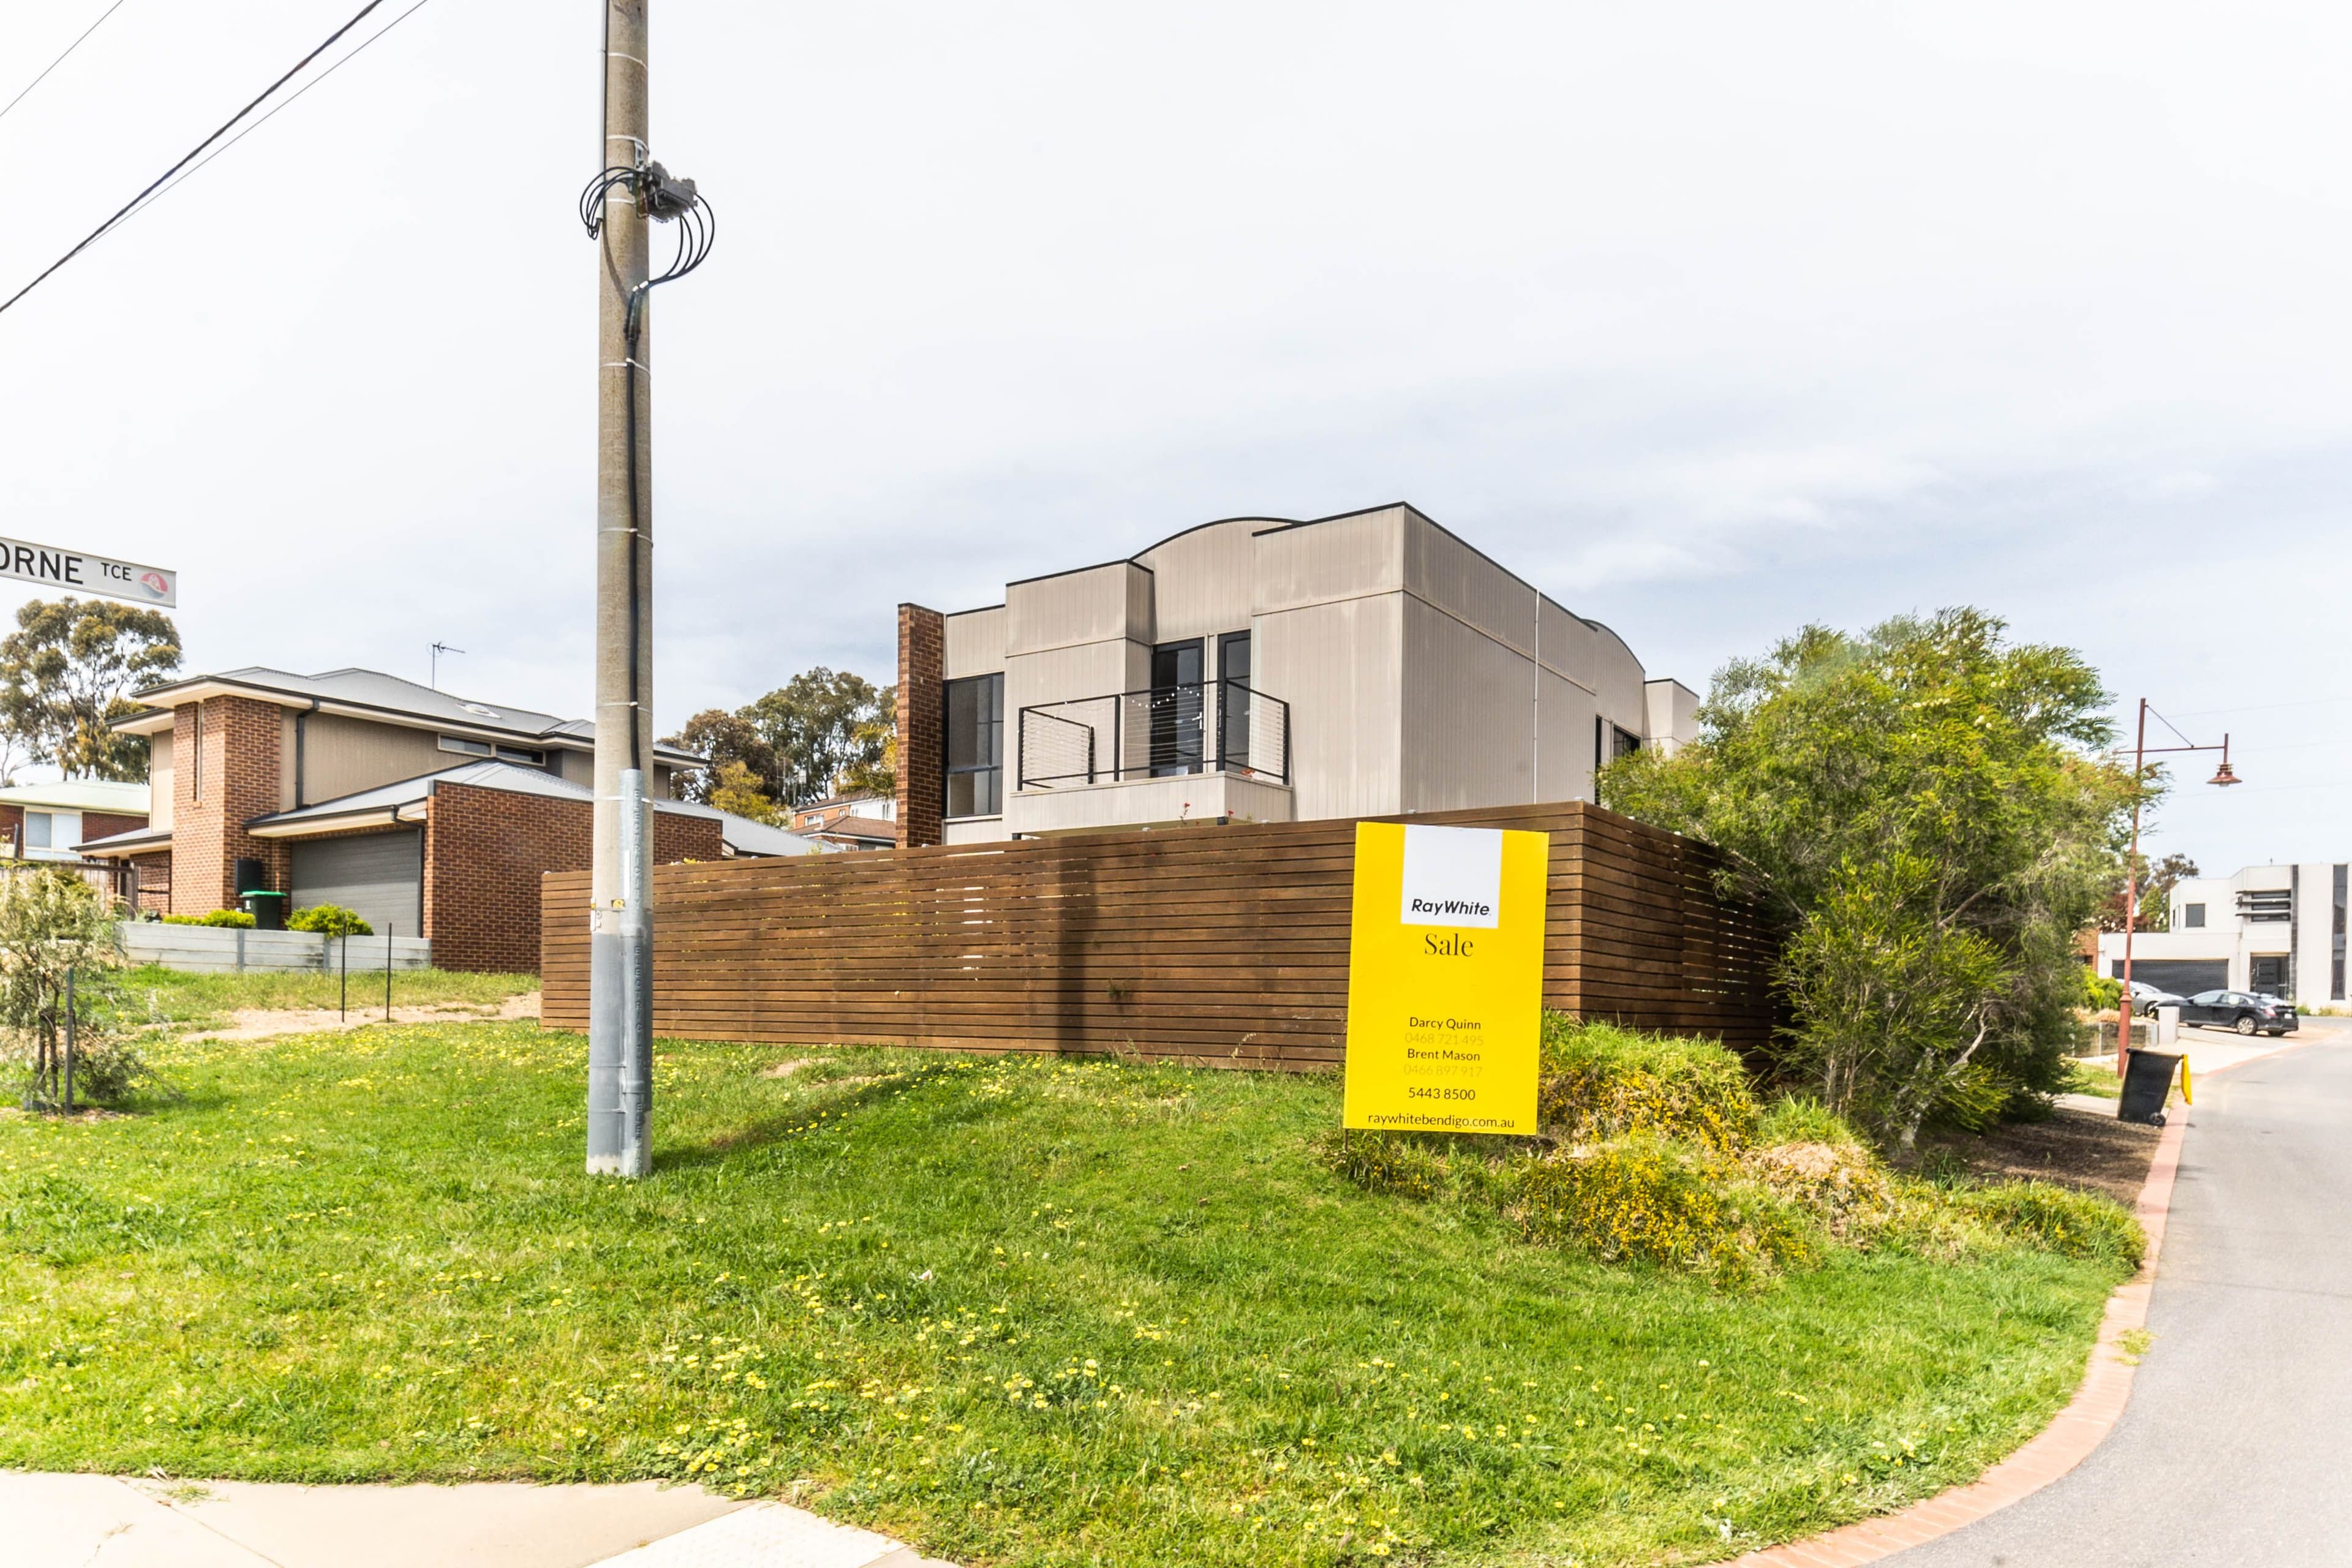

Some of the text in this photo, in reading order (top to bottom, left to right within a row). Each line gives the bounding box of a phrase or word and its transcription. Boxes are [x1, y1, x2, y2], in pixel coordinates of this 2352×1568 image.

[101, 562, 132, 581] TCE
[1424, 933, 1474, 957] Sale
[1409, 1017, 1481, 1030] Darcy Quinn
[1405, 1033, 1483, 1046] 0468 721 495
[1408, 1048, 1480, 1061] Brent Mason
[1409, 1087, 1476, 1100] 5443 8500
[1368, 1113, 1515, 1128] raywhitebendigo.com.au
